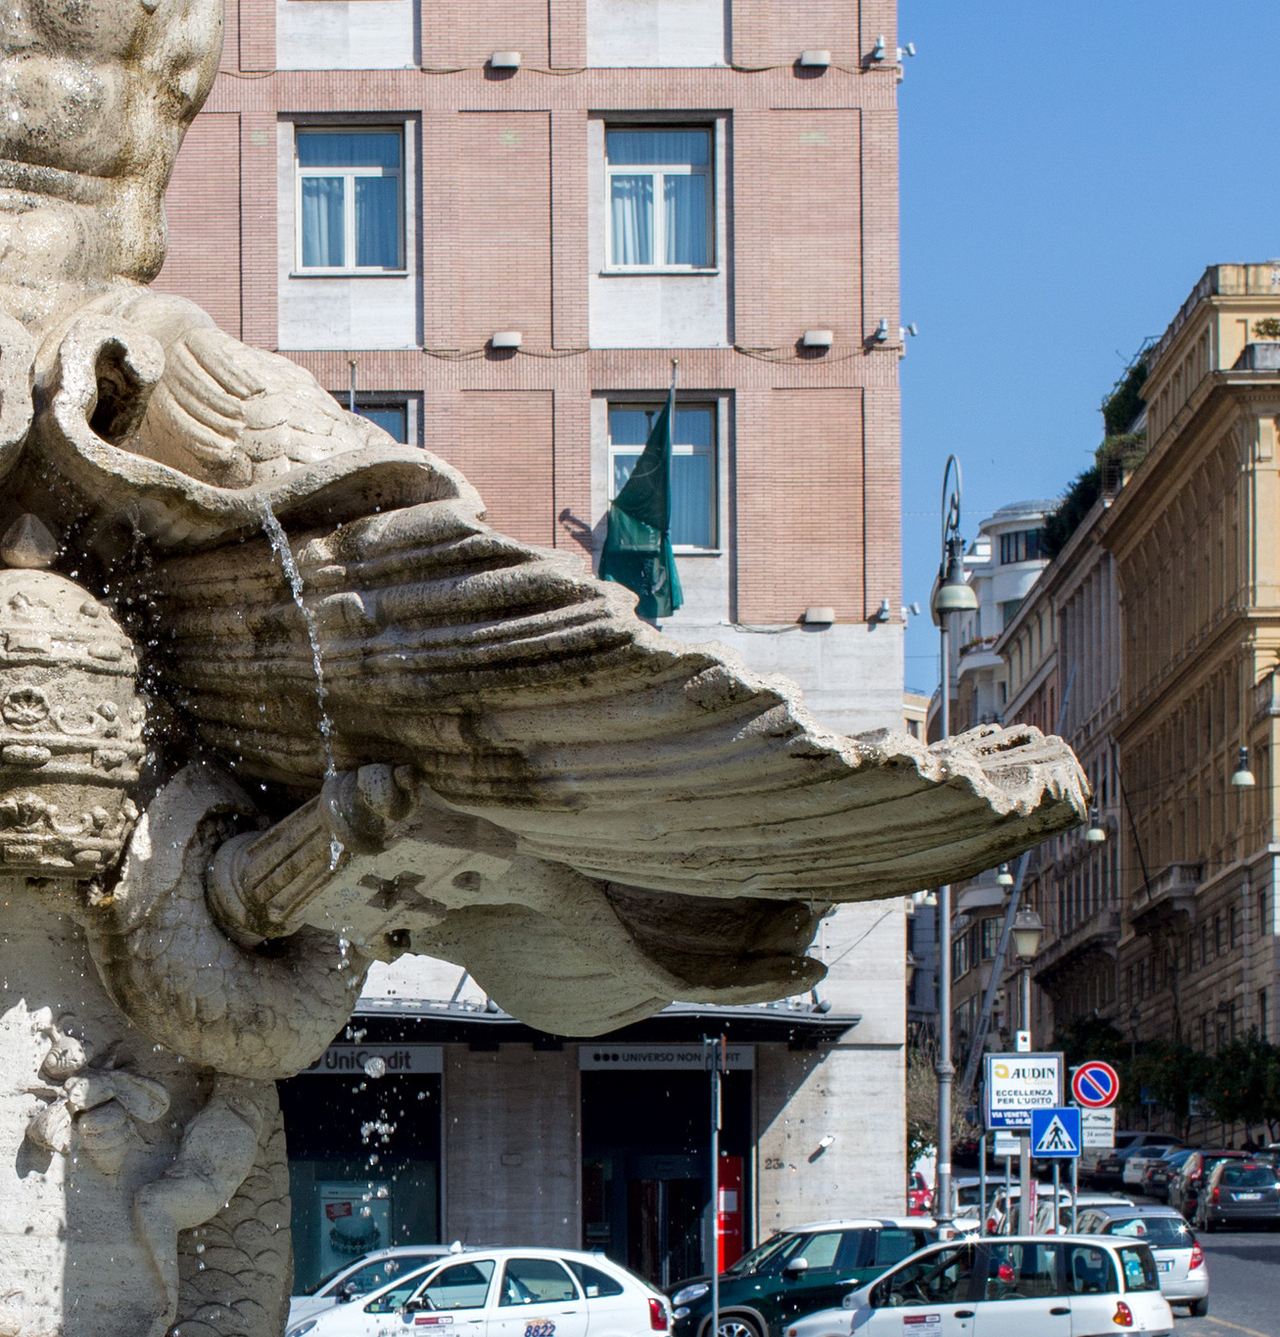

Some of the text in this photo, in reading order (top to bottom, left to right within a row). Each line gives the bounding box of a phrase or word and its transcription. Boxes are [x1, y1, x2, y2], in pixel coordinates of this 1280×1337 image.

[325, 1051, 411, 1069] UniCdit
[622, 1052, 674, 1062] UNIVERSO
[677, 1052, 701, 1062] NON
[1011, 1067, 1055, 1079] AUDIN
[524, 1324, 556, 1337] 8822
